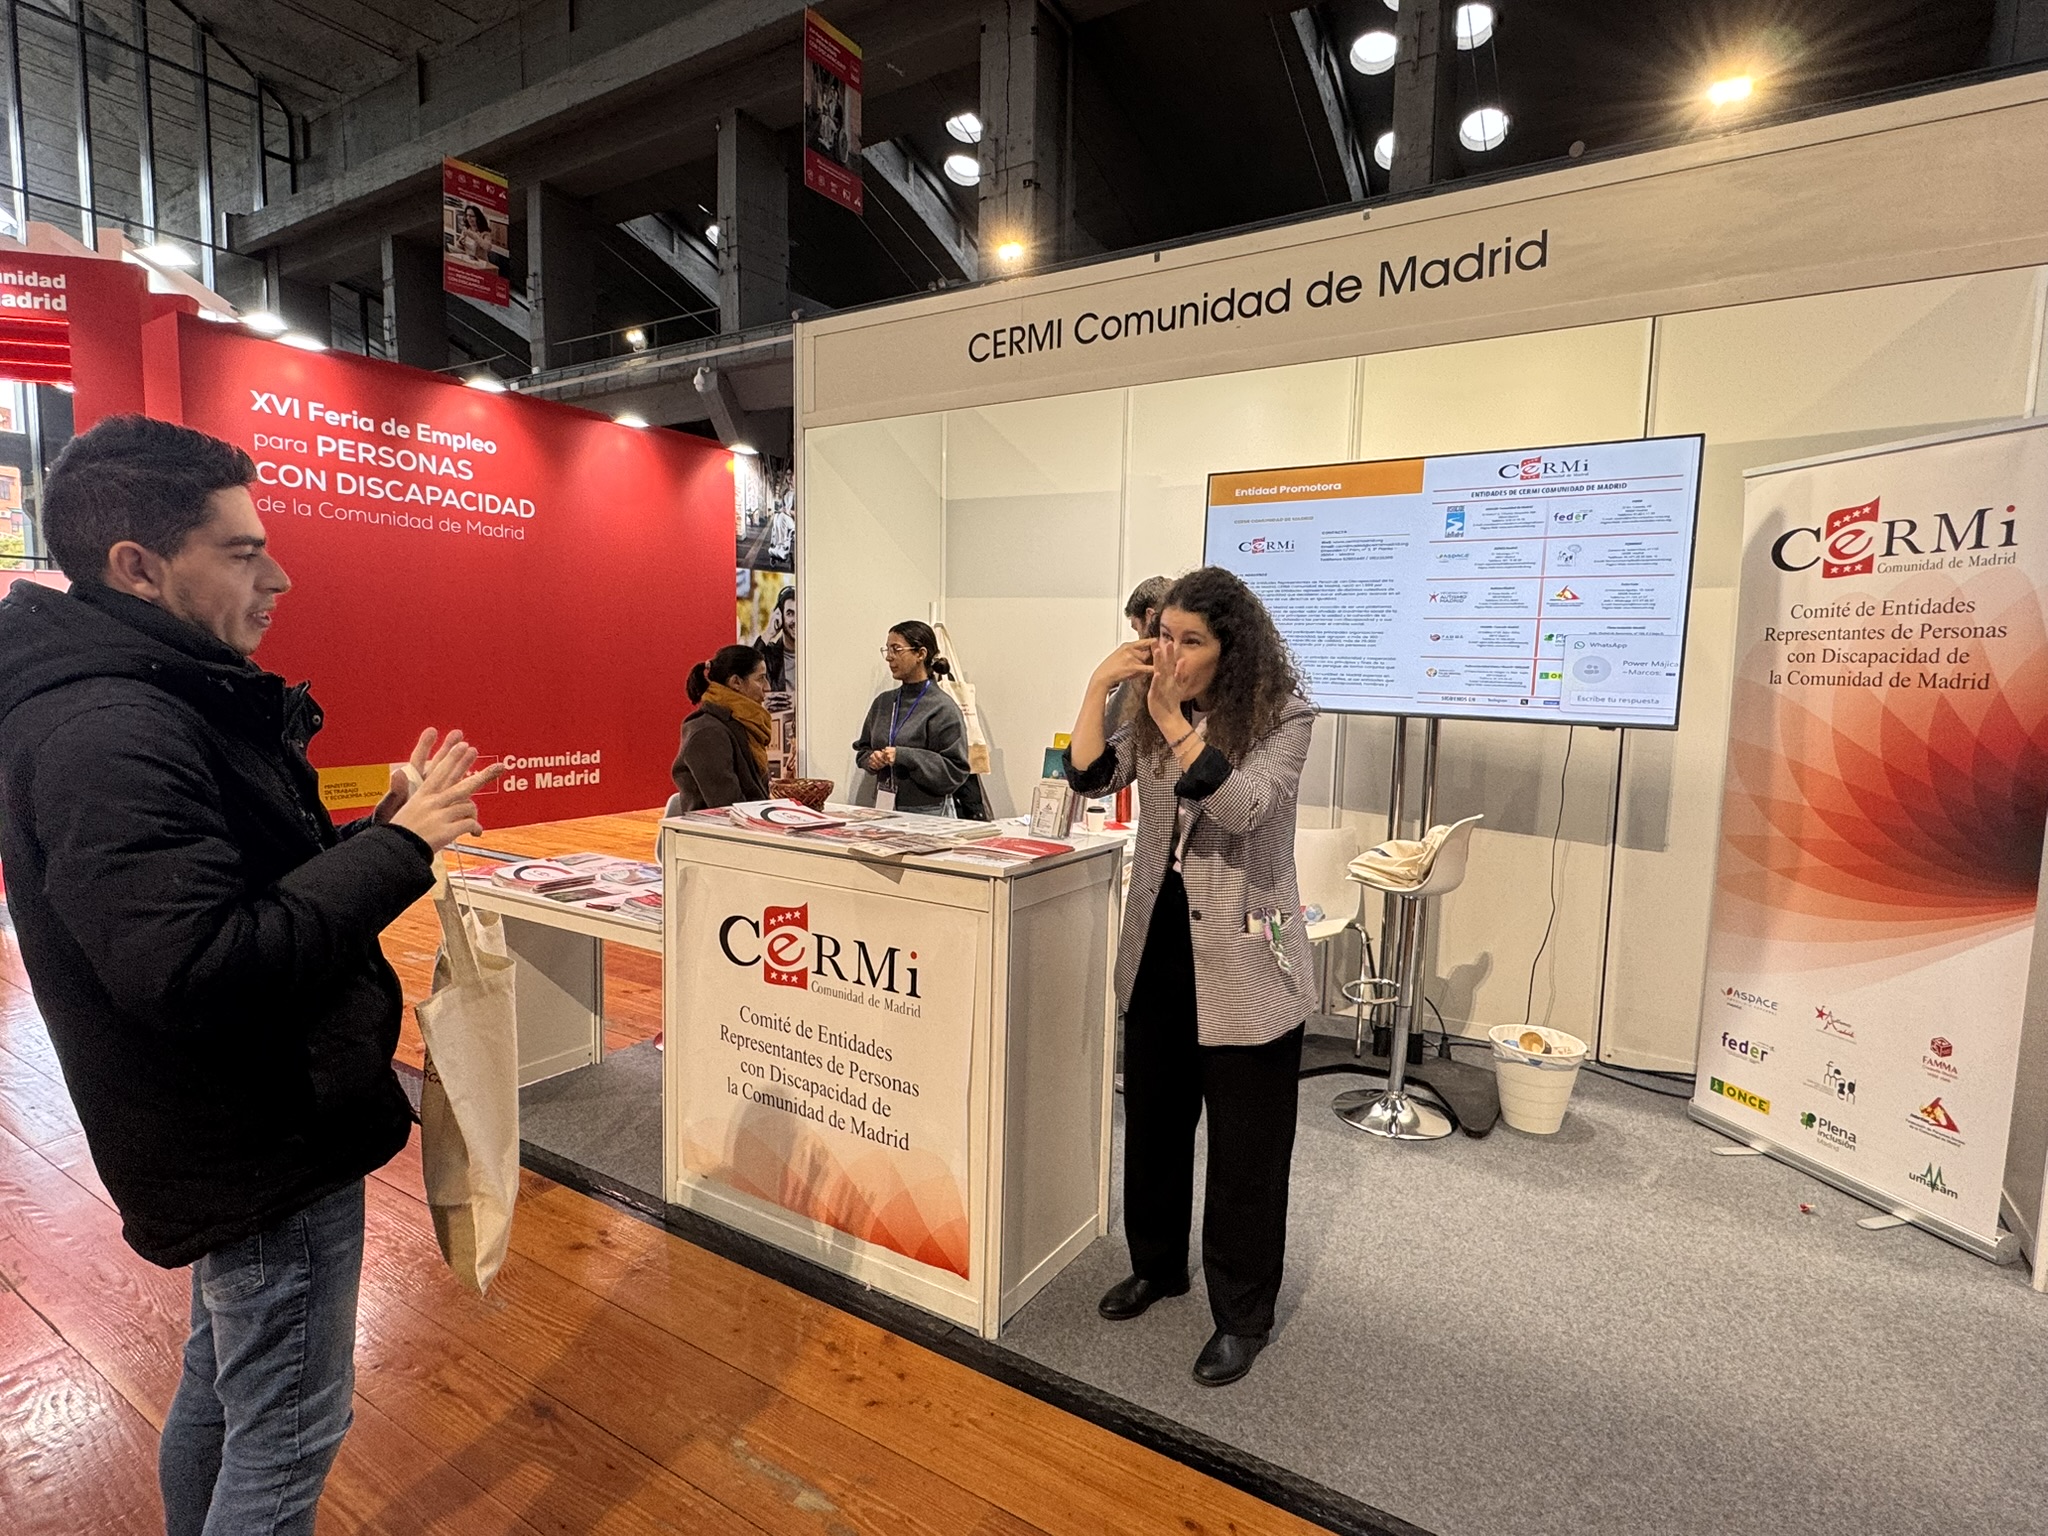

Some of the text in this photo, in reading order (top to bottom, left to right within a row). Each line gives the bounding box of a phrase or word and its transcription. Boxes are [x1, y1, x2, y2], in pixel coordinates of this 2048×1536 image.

[0, 291, 67, 311] adrid
[967, 229, 1549, 363] CERMI Comunidad de Madrid
[250, 389, 497, 455] XVI Feria de Empleo
[253, 432, 474, 481] para PERSONAS
[257, 461, 536, 519] CON DISCAPACIDAD
[1235, 482, 1342, 497] Entidad Promotora
[1471, 488, 1507, 498] ENTIDADES
[1508, 488, 1517, 496] DE
[1518, 487, 1541, 495] CERMI
[1541, 485, 1585, 494] COMUNIDAD
[1597, 482, 1627, 490] MADRID
[256, 495, 525, 540] de la Comunidad de Madrid
[1554, 511, 1588, 522] feder
[1877, 552, 2017, 574] Comunidad de Madrid
[1790, 597, 1976, 619] Comité de Entidades
[1764, 623, 2008, 645] Representantes de Personas
[1787, 648, 1970, 667] con Discapacidad de
[1768, 670, 1990, 690] la Comunidad de Madrid
[1577, 695, 1606, 703] Escribe
[1619, 697, 1660, 705] respuesta
[503, 750, 600, 770] Comunidad
[503, 768, 600, 792] de Madrid
[811, 981, 922, 1019] Comunidad de Madrid
[740, 1006, 893, 1062] Comité de Entidades
[1721, 1032, 1768, 1061] feder
[719, 1025, 920, 1098] Representantes de Personas
[1922, 1055, 1958, 1075] FAMMA
[741, 1060, 892, 1119] con Discapacidad de
[1726, 1086, 1768, 1112] ONCE
[727, 1077, 911, 1152] la Comunidad de Madrid
[1817, 1130, 1856, 1152] inclusión
[1819, 1117, 1857, 1144] Plena
[1909, 1172, 1958, 1200] umasam
